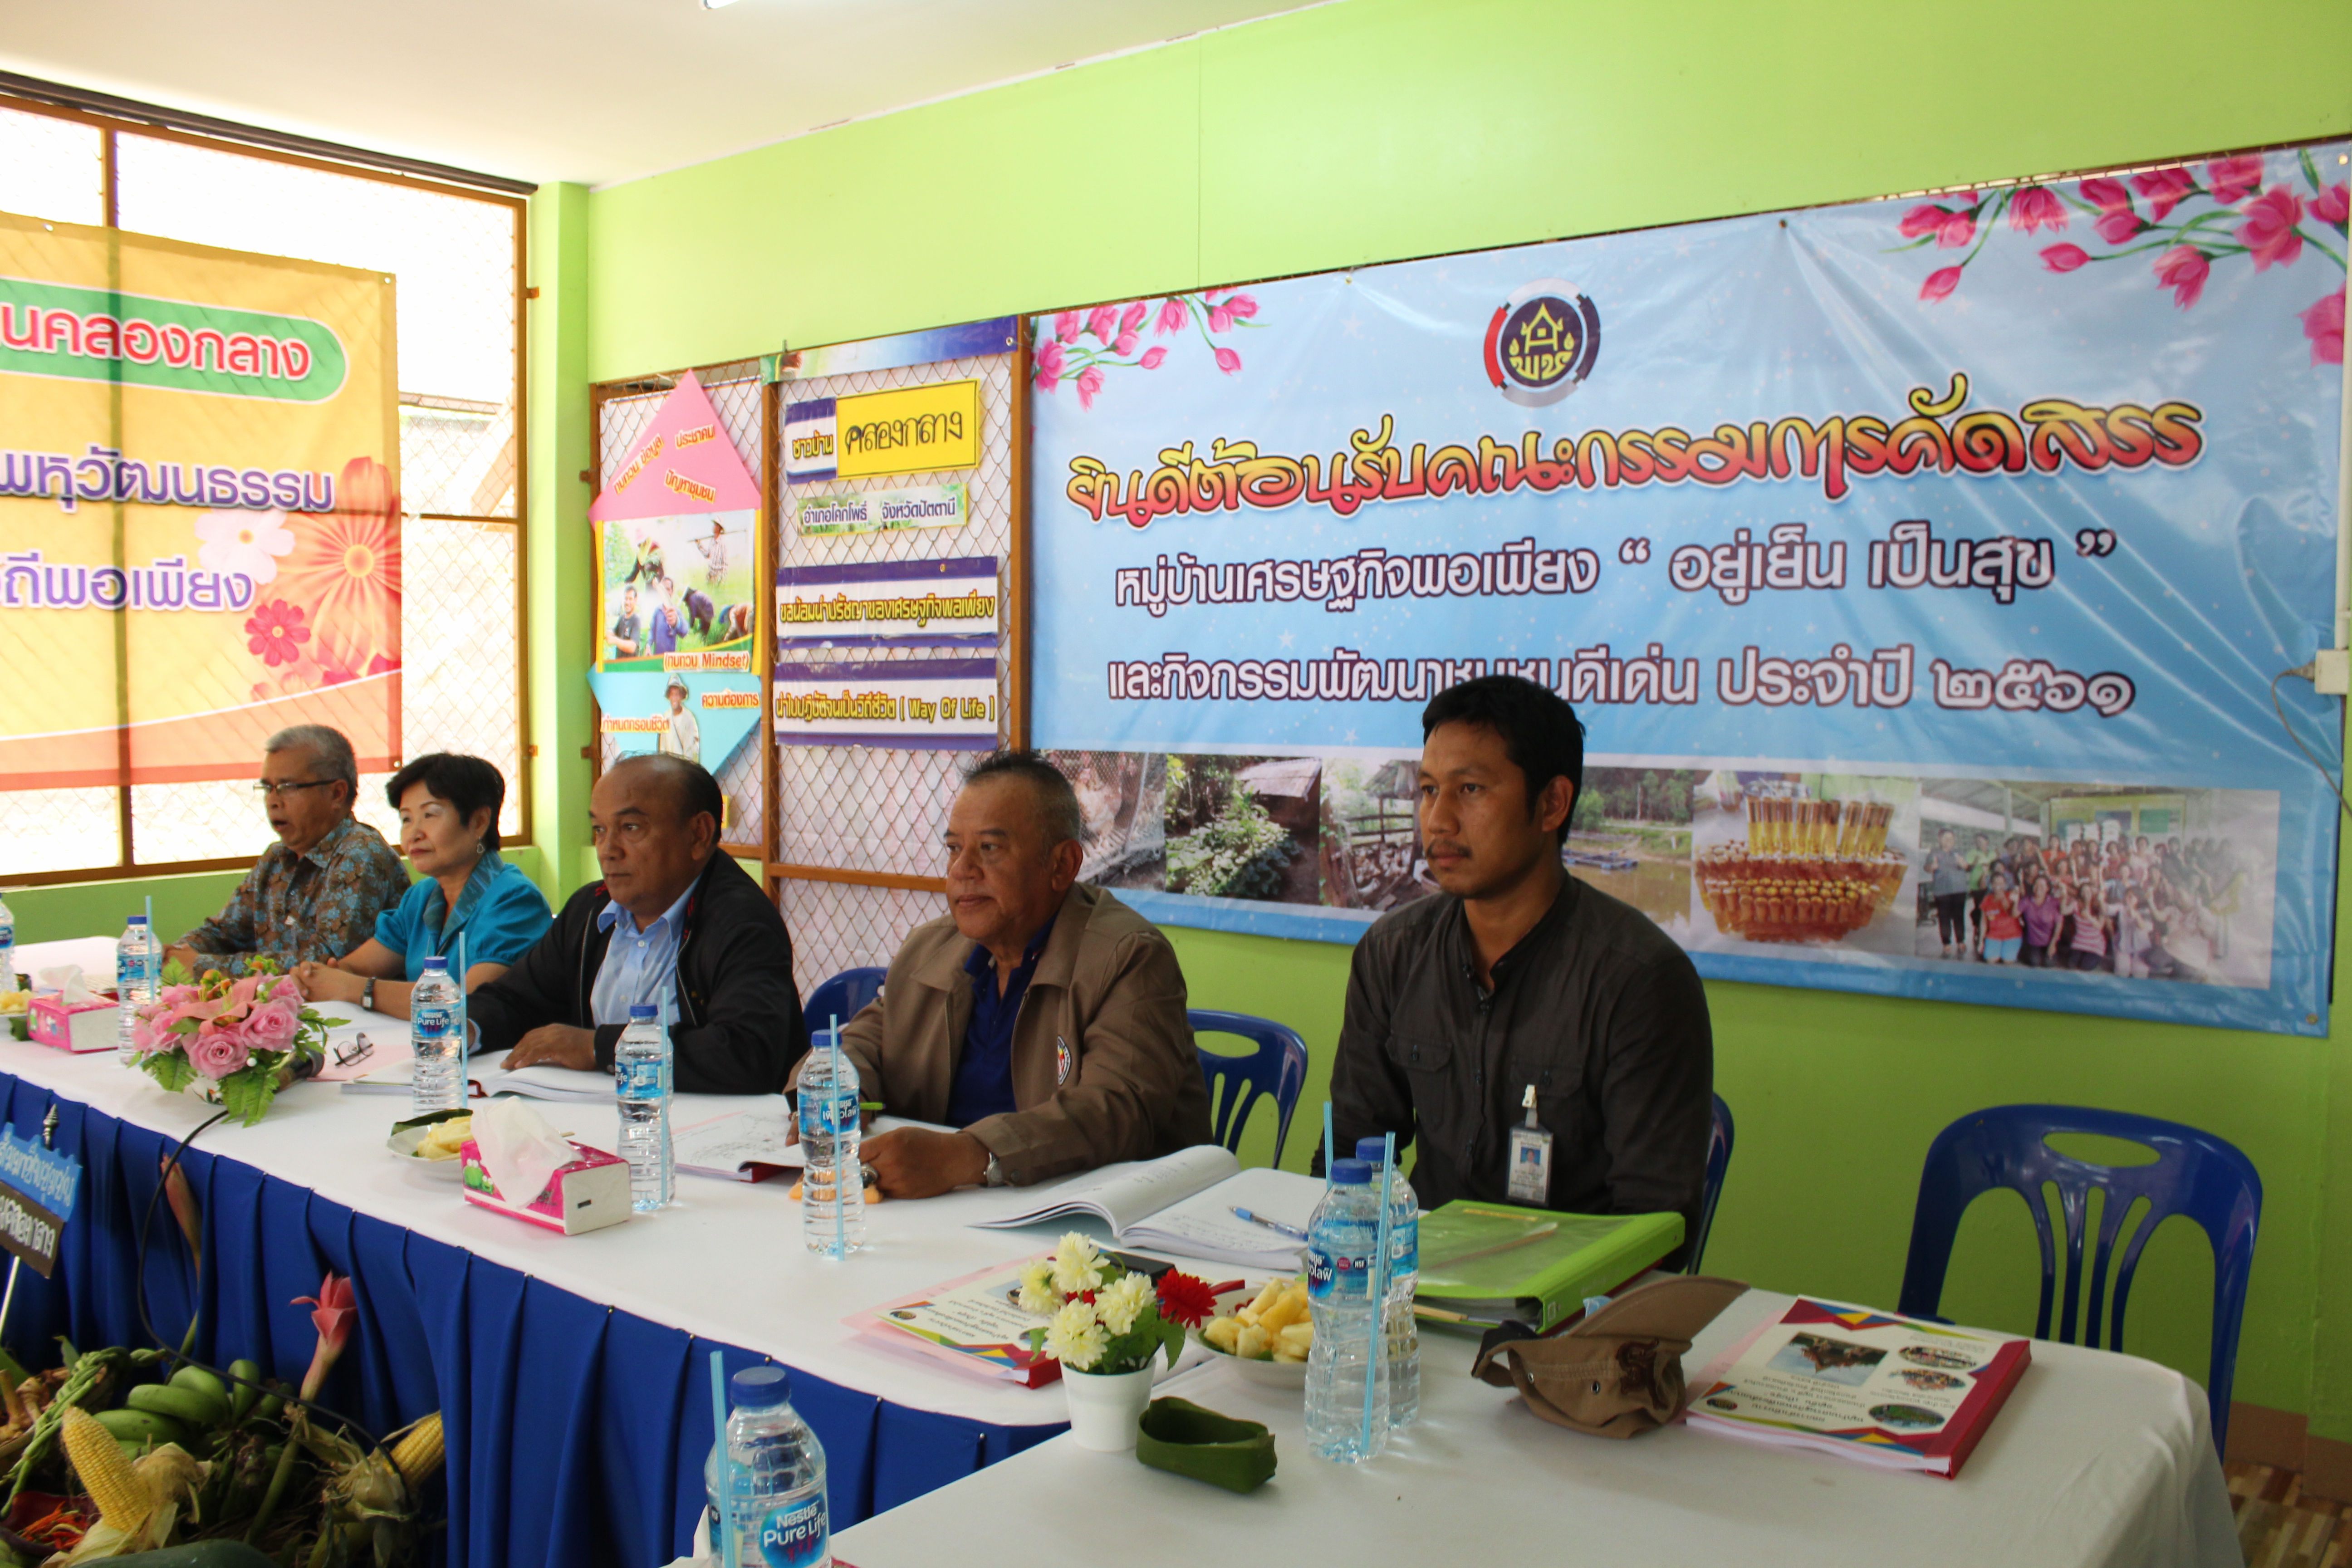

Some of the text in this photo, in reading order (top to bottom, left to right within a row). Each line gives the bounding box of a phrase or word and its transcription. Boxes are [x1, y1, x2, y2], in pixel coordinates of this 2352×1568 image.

[0, 302, 311, 380] นคลองกลาง
[793, 430, 833, 459] ชาวบ้าน
[845, 411, 963, 456] คลองกลาง
[1066, 372, 2204, 528] ยินดีต้อนรับคณะกรรมการคัดสรร
[803, 497, 956, 524] อำเภอโคกโพธิ์ จังหวัดปัตตานี
[0, 550, 255, 612] ถีพอเพียง
[1115, 536, 1599, 616] หมู่บ้านเศรษฐกิจพอเพียง
[1670, 523, 1845, 605] อยู่เย็น
[1868, 520, 2056, 603] เป็นสุข
[1718, 642, 1914, 709] ประจำปี
[1930, 656, 2135, 716] ๒๕๖๑
[908, 697, 936, 723] Way
[941, 696, 957, 718] Of
[960, 696, 985, 718] Life
[418, 1017, 449, 1028] Pure Life
[763, 1527, 806, 1547] Pure
